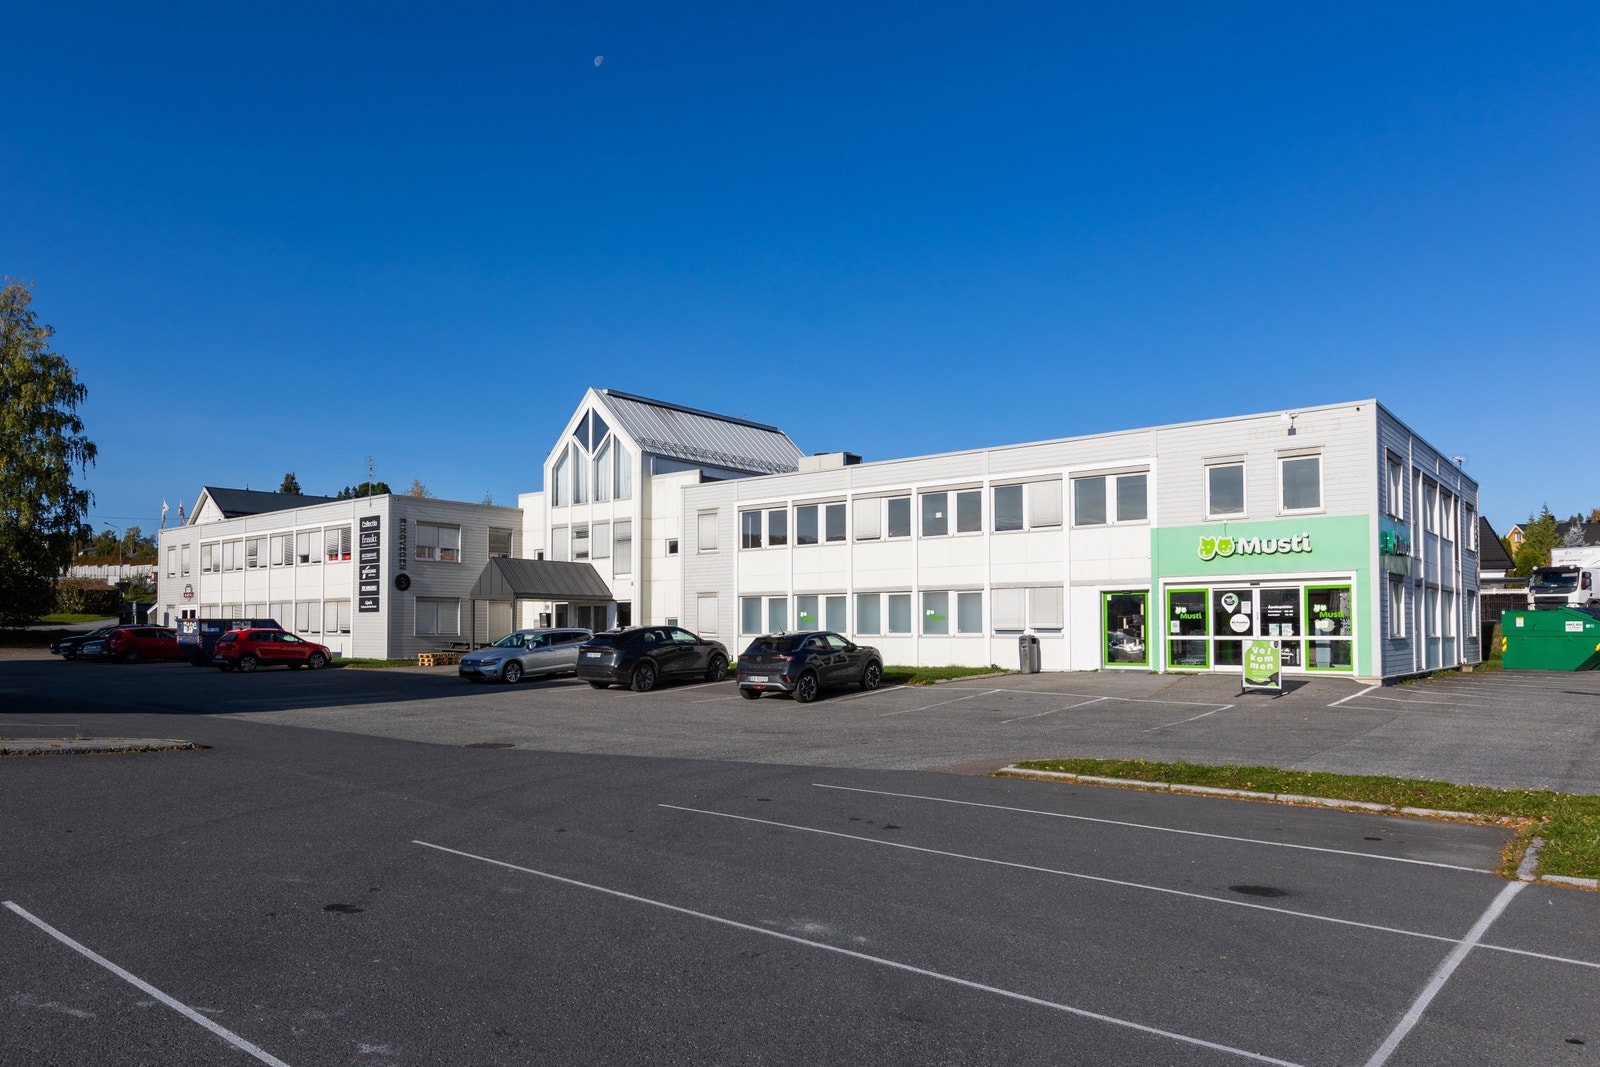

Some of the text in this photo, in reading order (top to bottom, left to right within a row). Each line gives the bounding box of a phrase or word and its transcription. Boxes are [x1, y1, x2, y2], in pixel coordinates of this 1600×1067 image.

[1237, 532, 1312, 555] Musti
[1180, 612, 1202, 620] Musti
[1319, 611, 1345, 619] Musti
[1251, 646, 1272, 655] Vel
[1250, 653, 1274, 663] kom
[1250, 662, 1274, 670] men
